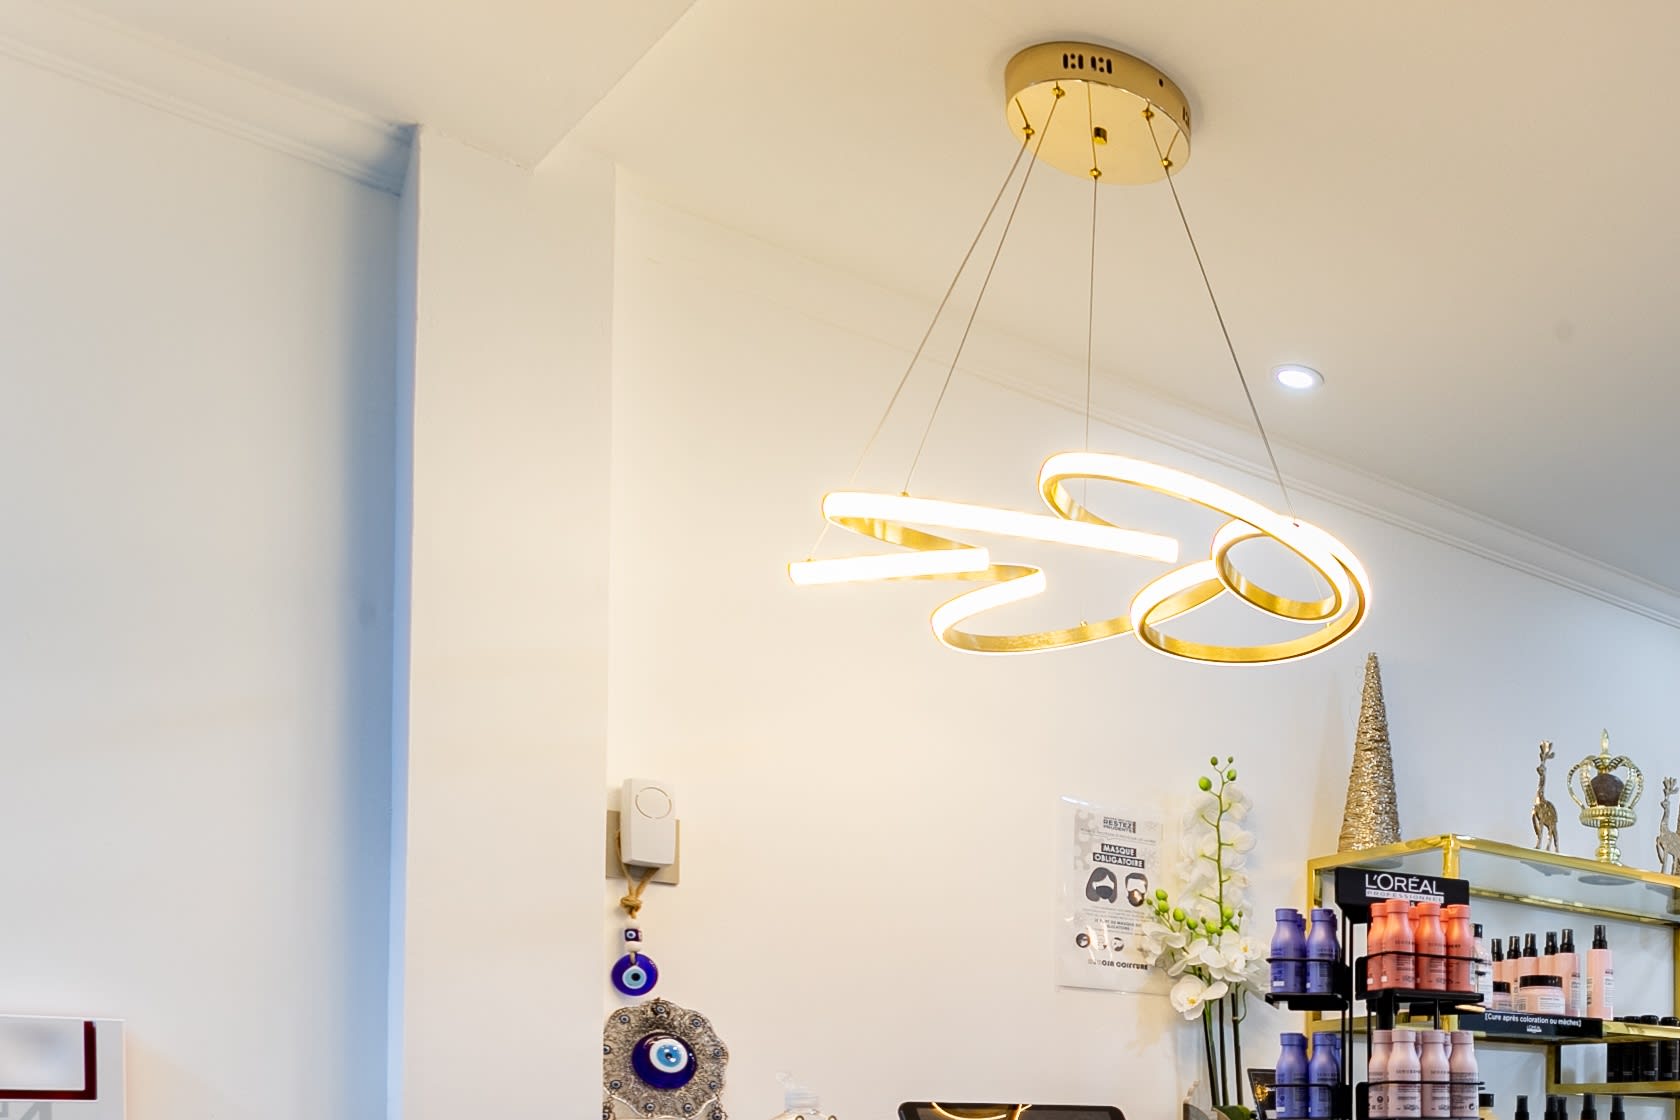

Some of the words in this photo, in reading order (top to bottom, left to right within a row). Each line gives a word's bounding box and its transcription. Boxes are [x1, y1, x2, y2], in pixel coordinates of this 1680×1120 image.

[1102, 844, 1135, 856] MASQUE
[1094, 853, 1143, 868] OBLIGATOIRE
[1365, 873, 1445, 895] L'ORÉAL
[1366, 889, 1444, 903] PROFESSIONNEL
[1116, 961, 1148, 970] COIFFURE
[1502, 1014, 1519, 1022] après
[1520, 1016, 1549, 1024] coloration
